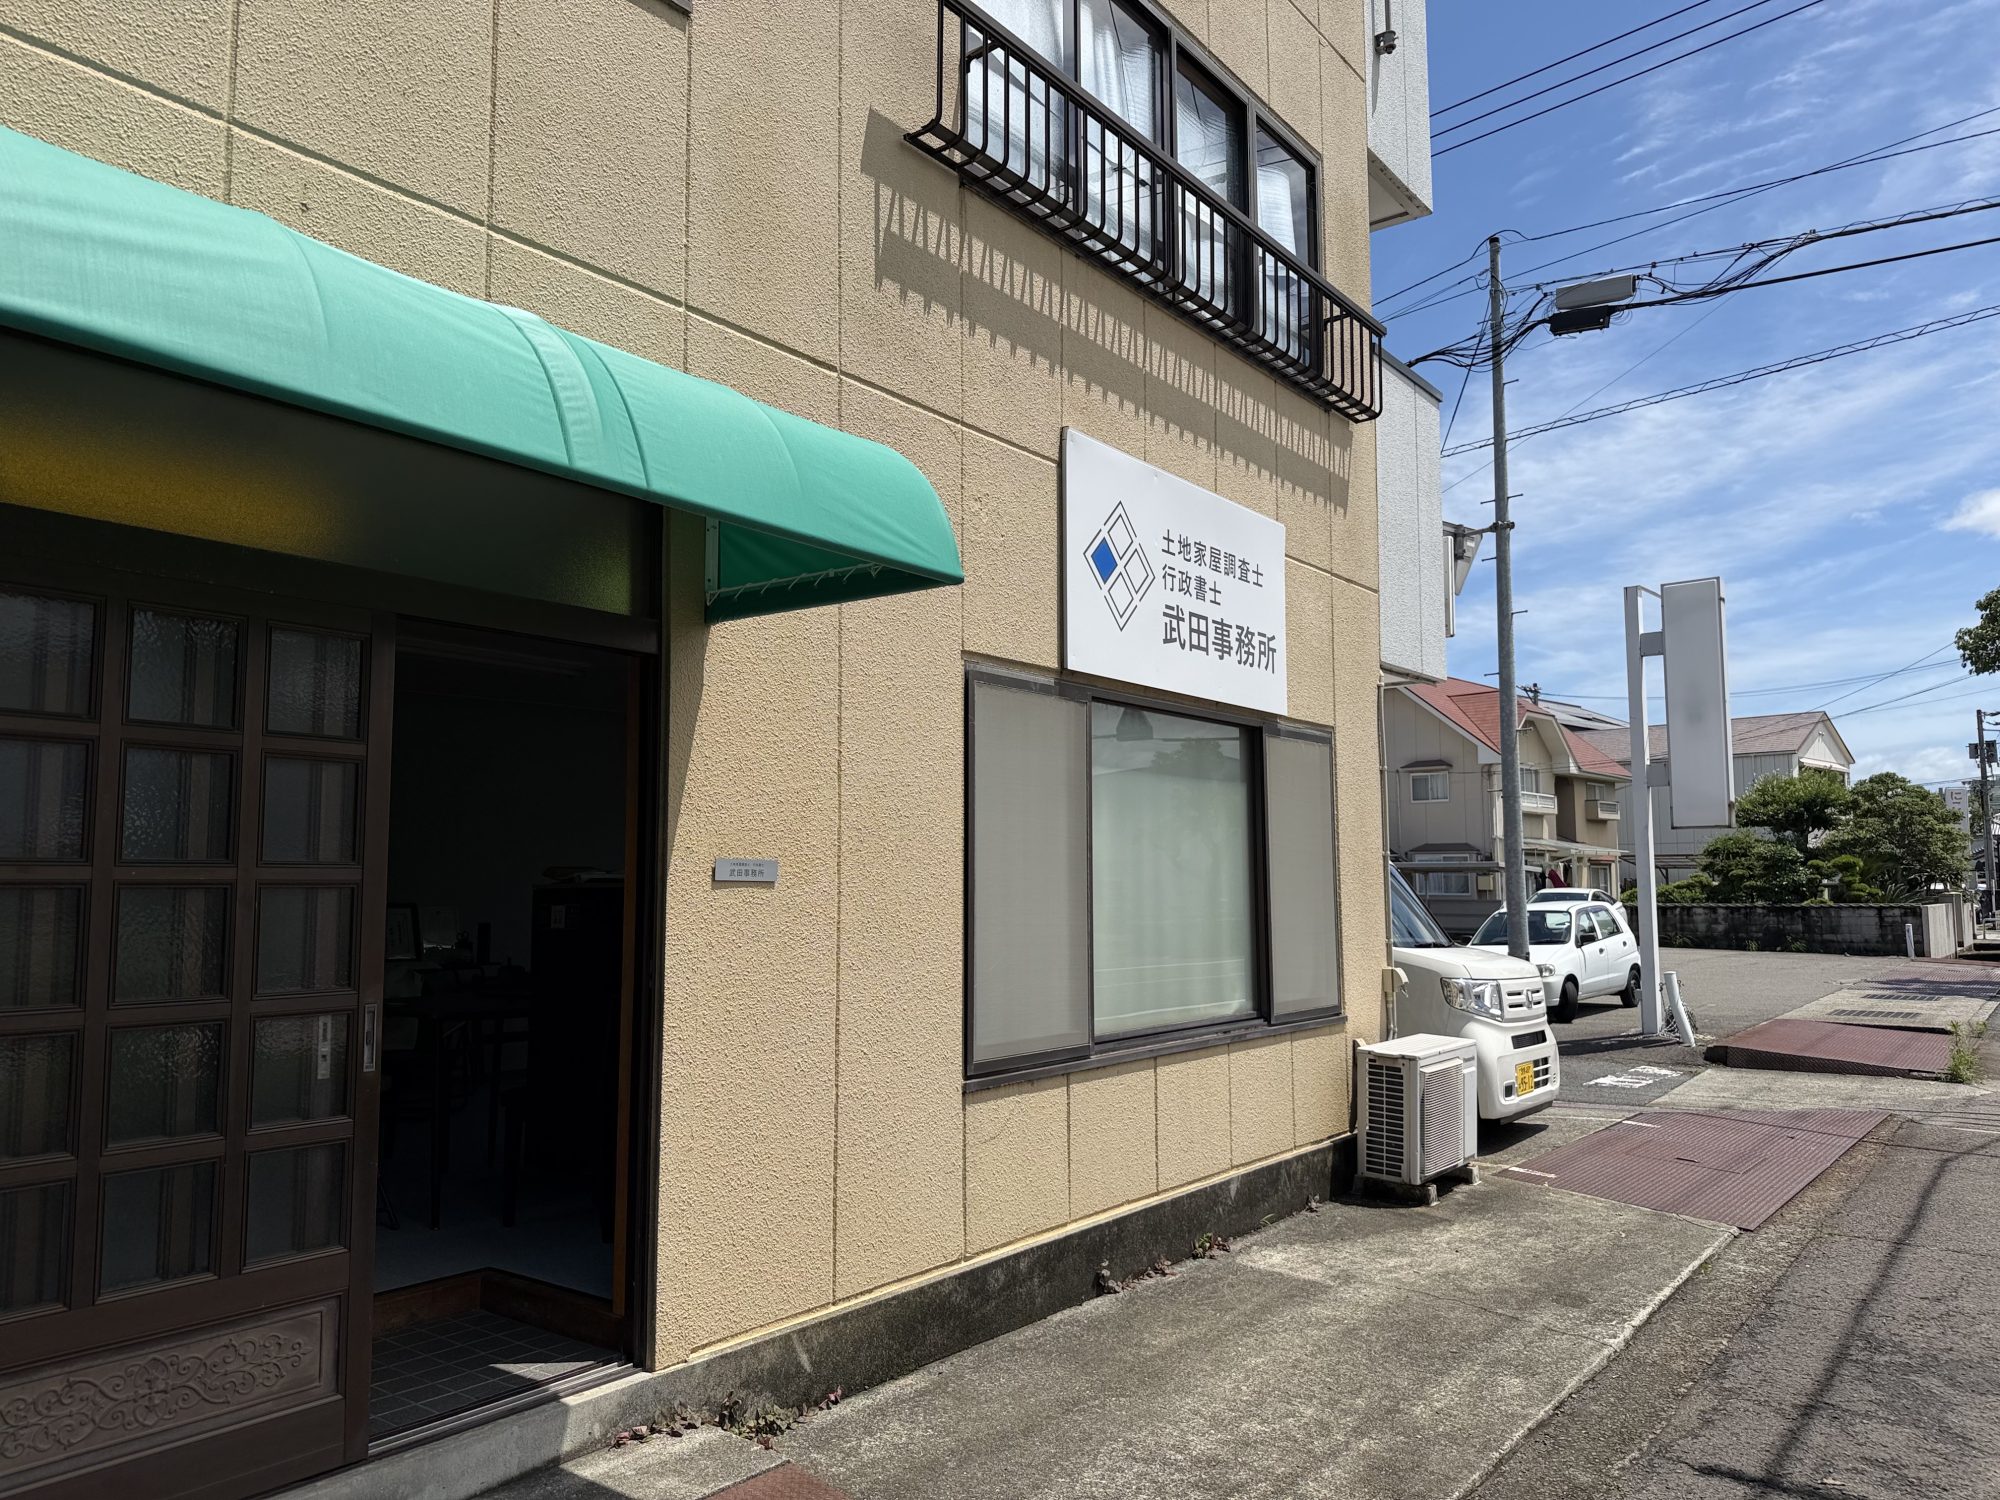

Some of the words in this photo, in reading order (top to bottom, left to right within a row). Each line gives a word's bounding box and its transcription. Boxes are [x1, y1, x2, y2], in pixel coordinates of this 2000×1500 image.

[1161, 529, 1264, 588] 土地家屋調査士
[1162, 564, 1222, 606] 行政書士
[1162, 604, 1277, 674] 武田事務所
[729, 869, 765, 878] 武田事務所
